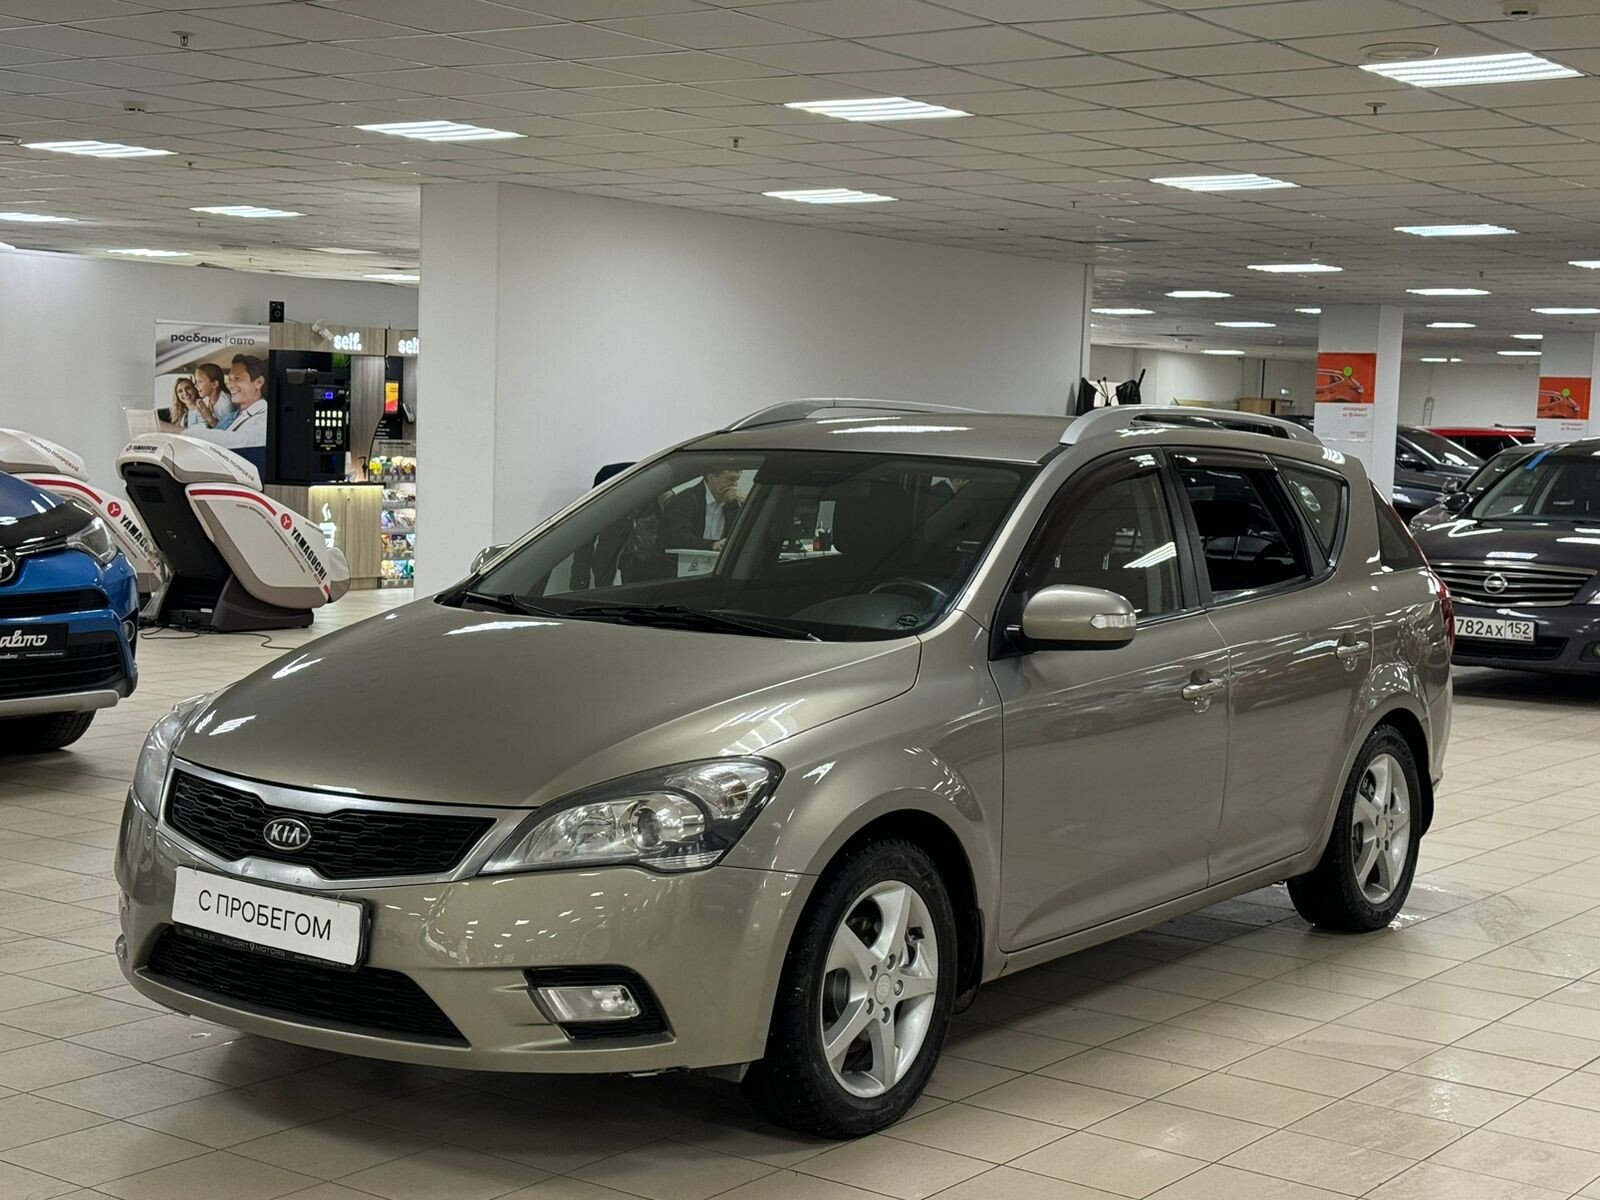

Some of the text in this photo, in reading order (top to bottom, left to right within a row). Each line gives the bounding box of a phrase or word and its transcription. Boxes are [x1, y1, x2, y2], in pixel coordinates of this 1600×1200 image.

[170, 332, 255, 345] росбанк авто
[333, 332, 362, 351] self.
[290, 527, 328, 581] YAMAGUCHI
[1507, 622, 1530, 635] 152
[269, 823, 301, 845] KIA
[198, 889, 212, 911] С
[216, 893, 332, 941] ПРОБЕГОМ
